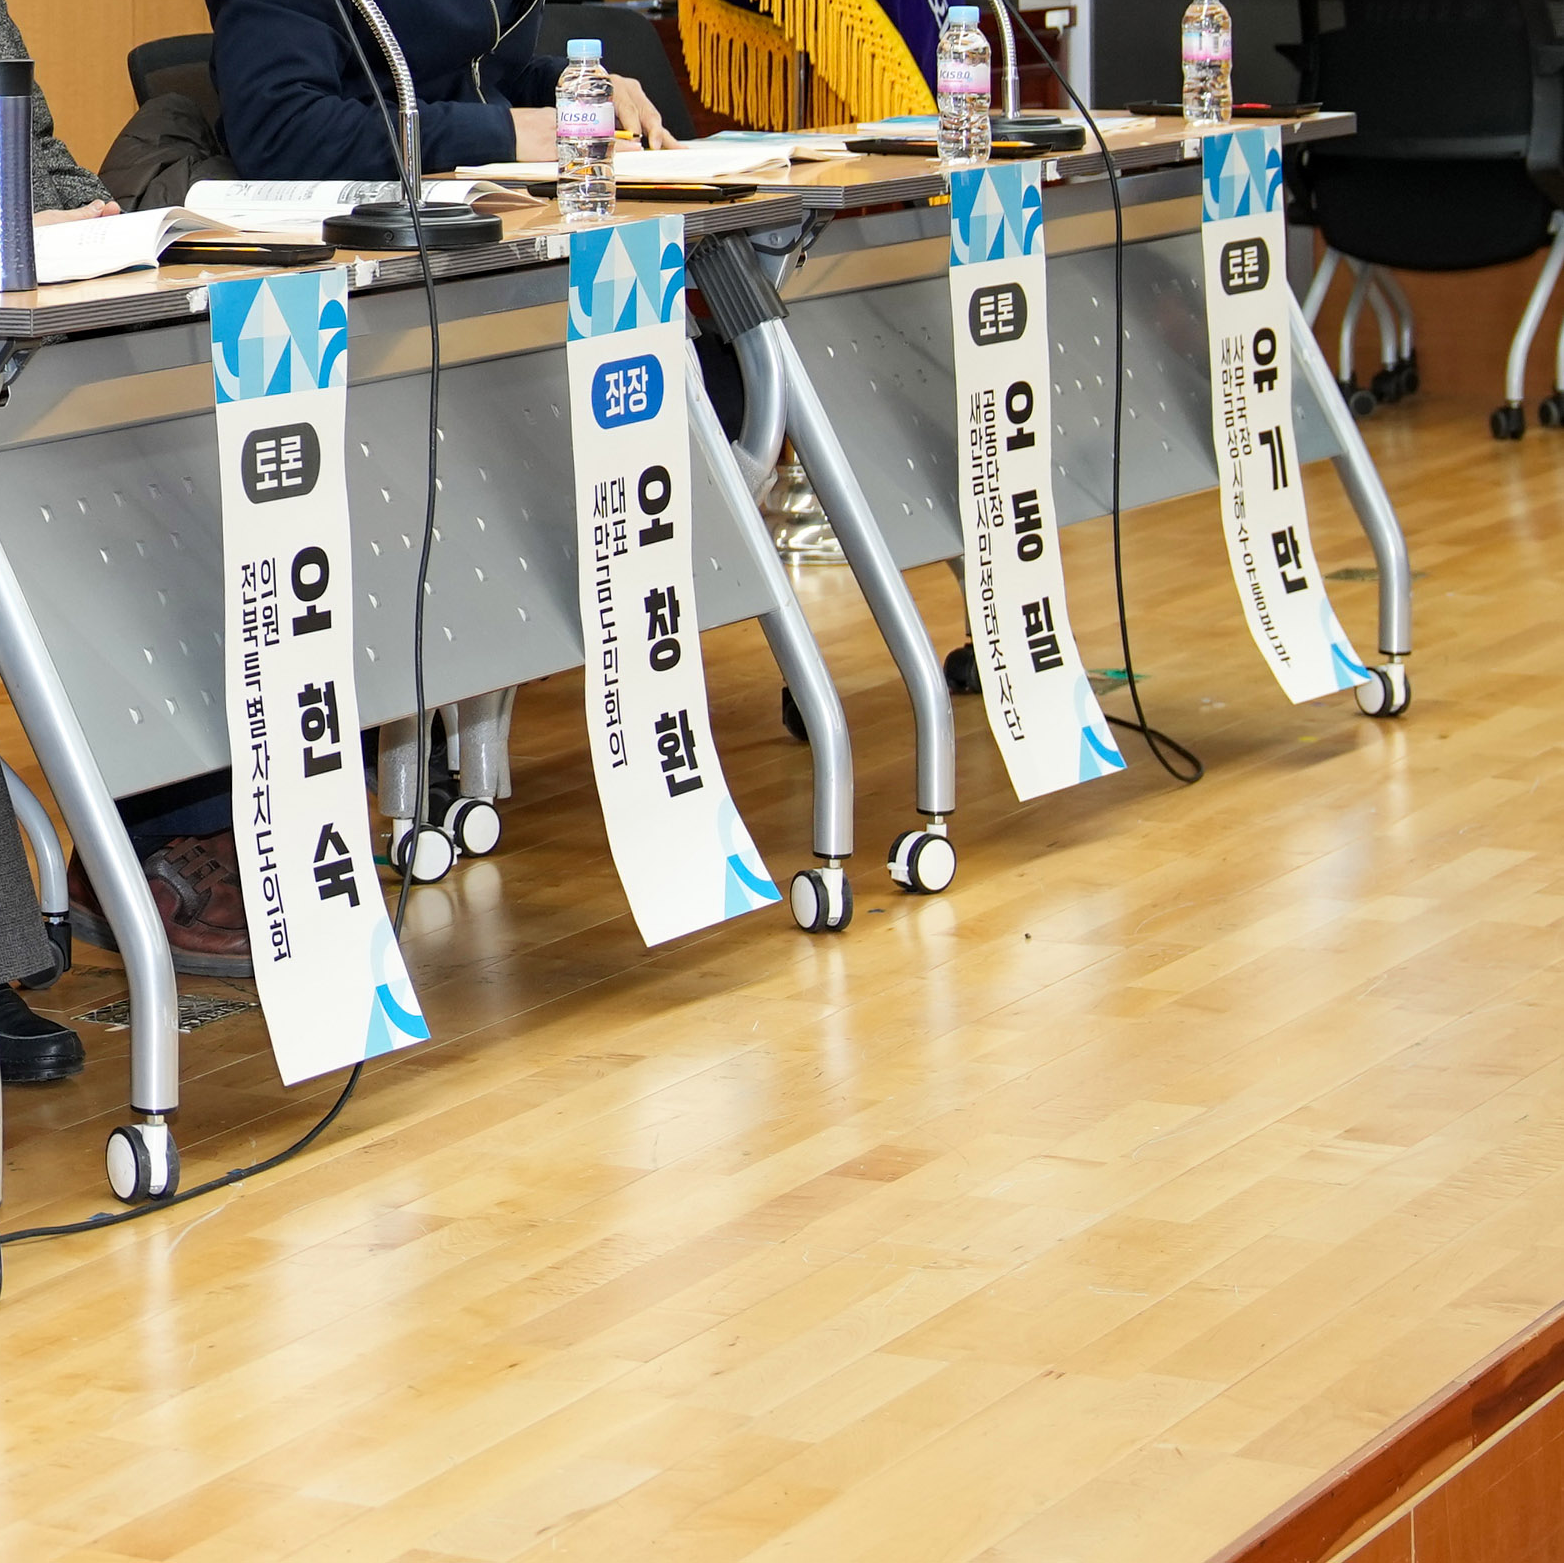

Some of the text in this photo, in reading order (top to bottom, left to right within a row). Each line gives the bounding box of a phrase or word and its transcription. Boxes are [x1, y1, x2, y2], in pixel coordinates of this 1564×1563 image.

[979, 291, 1015, 337] 토론
[1228, 245, 1260, 288] 토론
[603, 364, 650, 419] 좌장
[982, 388, 1005, 529] 공동단장
[1232, 333, 1253, 457] 사무국장
[1252, 326, 1309, 595] 유기만
[254, 434, 304, 492] 토론
[609, 476, 629, 557] 대표
[1004, 379, 1065, 674] 오동필
[259, 556, 280, 648] 의원
[592, 480, 629, 769] 새만금도민회의
[637, 464, 705, 799] 오창환
[969, 391, 1026, 743] 새만금시민생태조사단
[240, 560, 292, 963] 전북특별자치도의회
[290, 545, 362, 909] 오현숙
